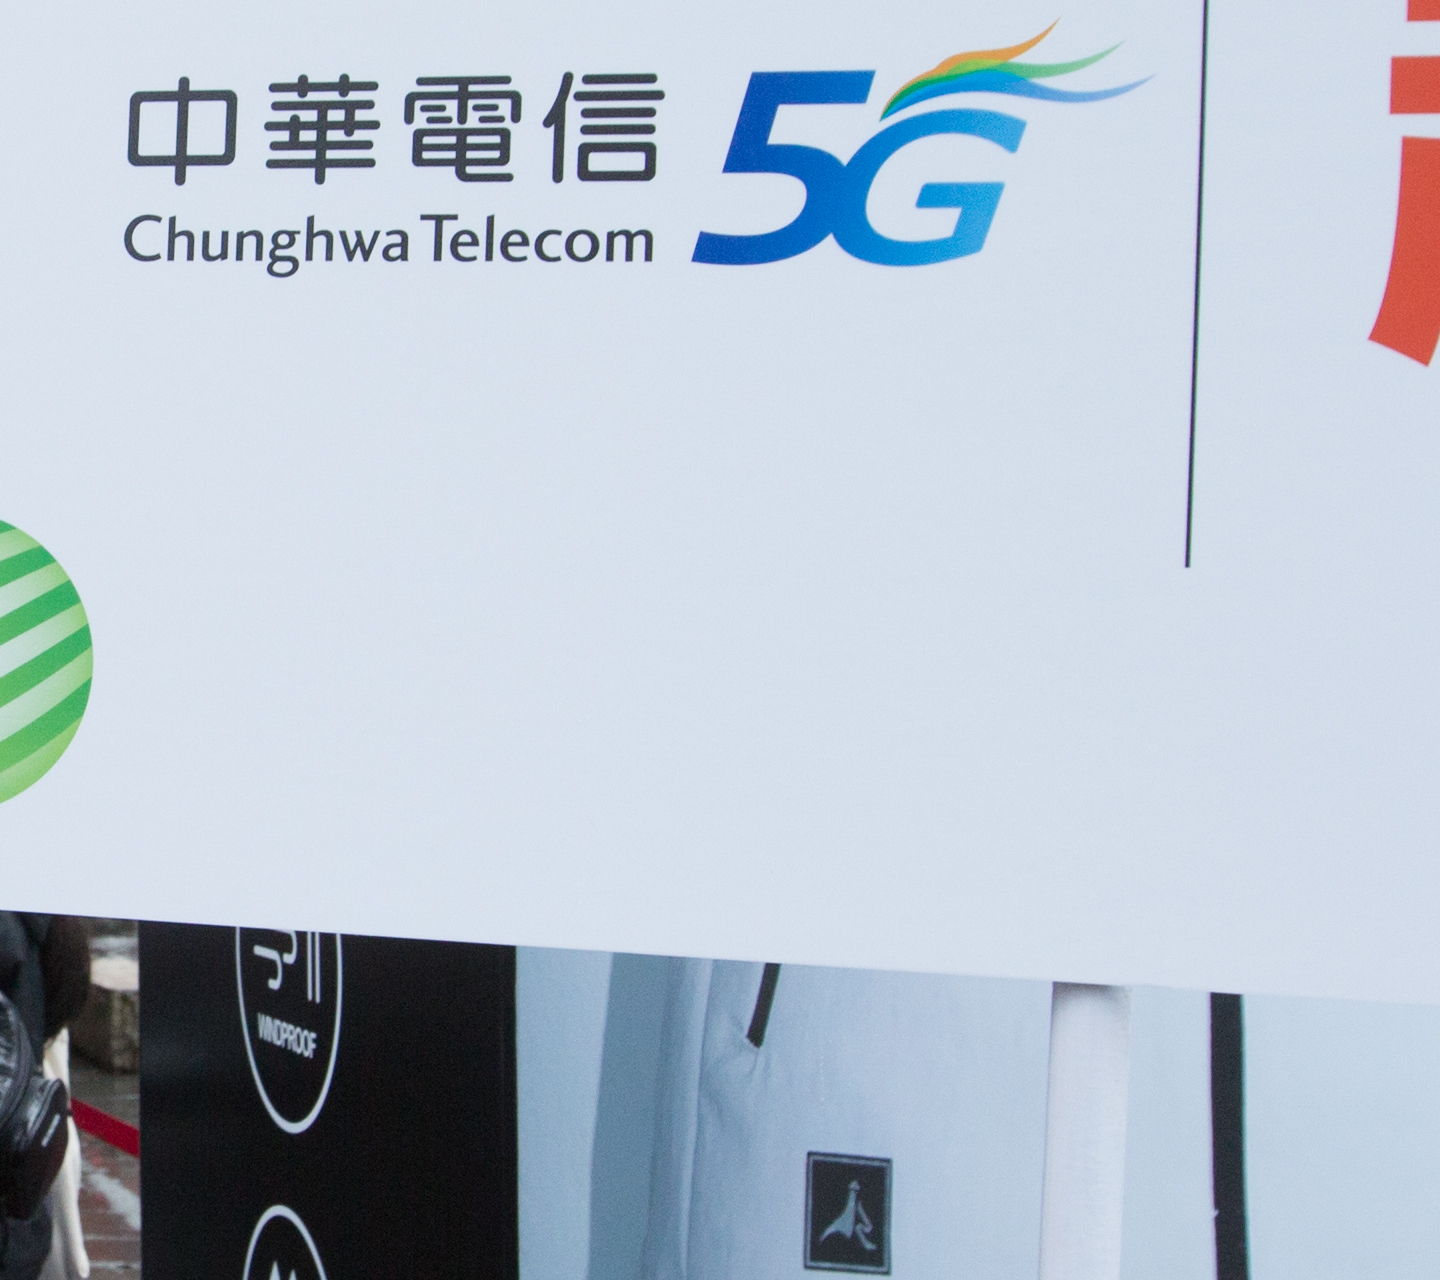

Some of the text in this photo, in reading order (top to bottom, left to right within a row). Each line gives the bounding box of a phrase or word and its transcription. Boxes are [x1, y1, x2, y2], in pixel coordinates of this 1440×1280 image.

[126, 71, 666, 186] 中華電信
[690, 68, 1029, 268] 5G
[122, 211, 655, 279] Chunghwa Telecom
